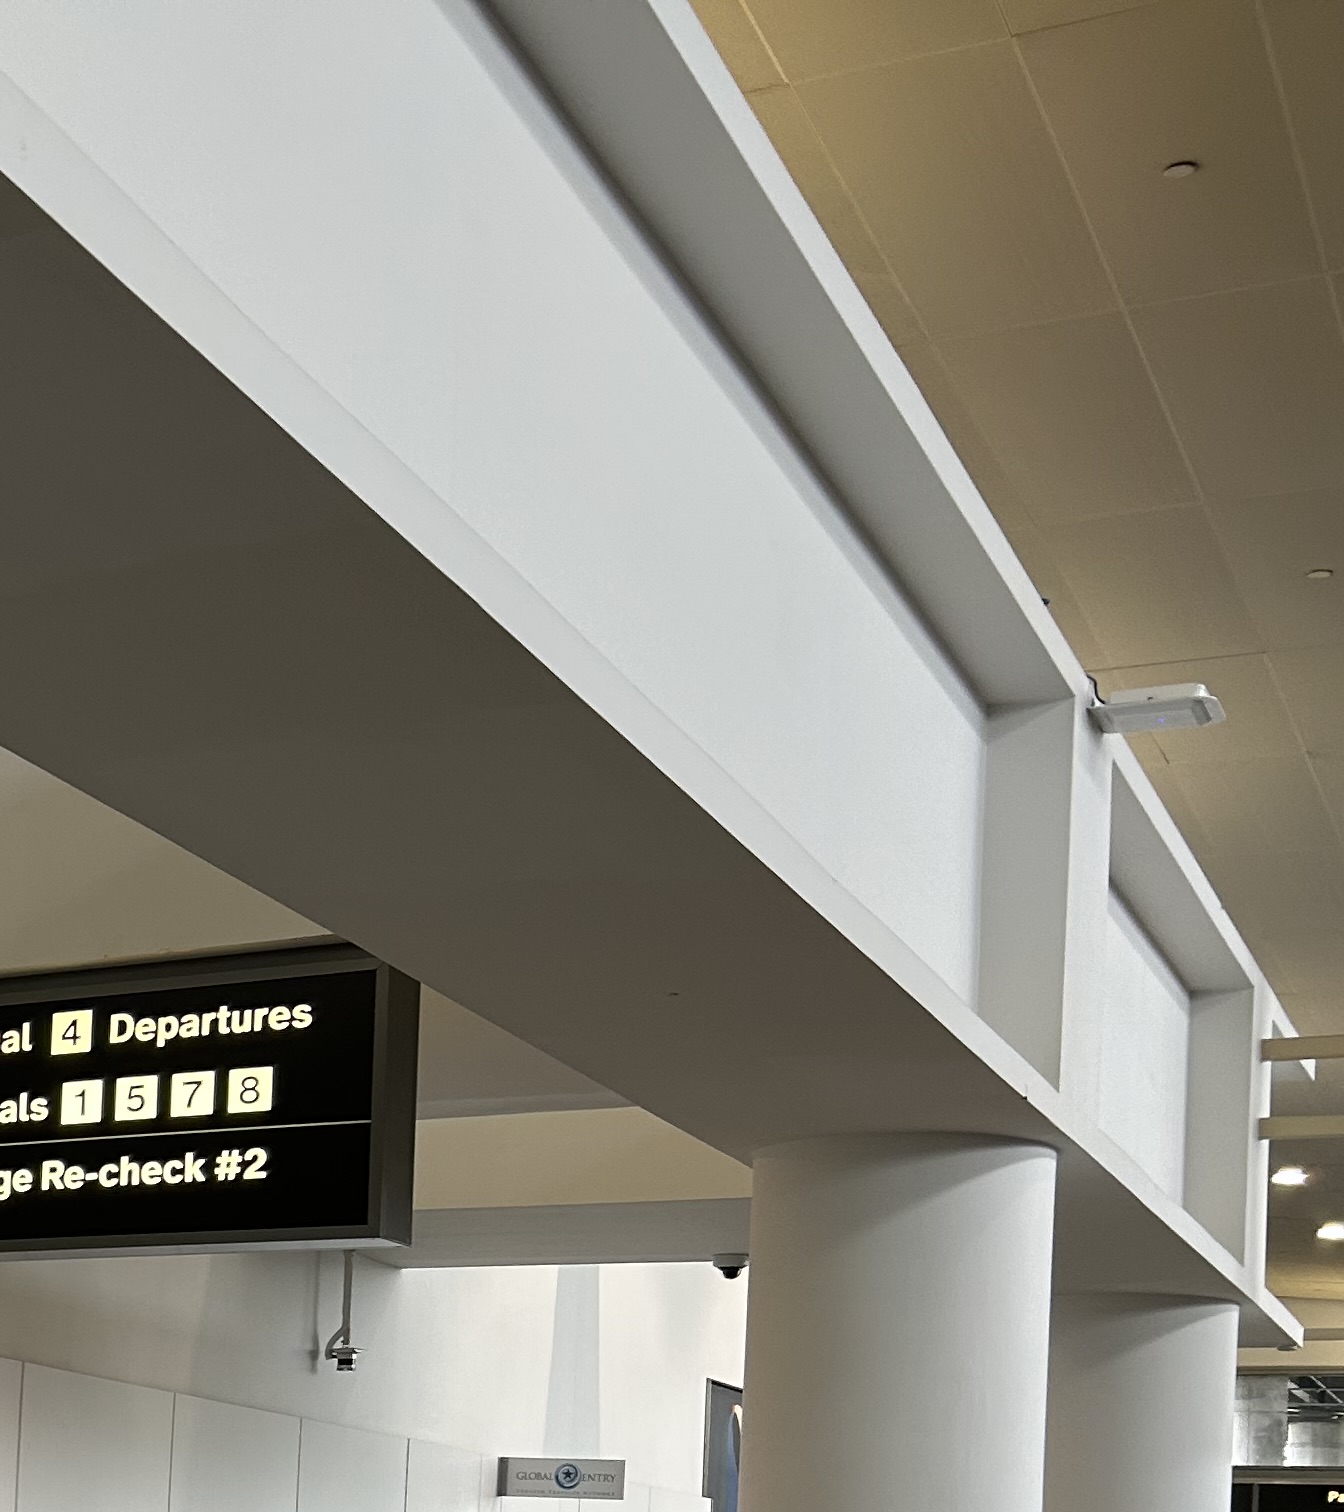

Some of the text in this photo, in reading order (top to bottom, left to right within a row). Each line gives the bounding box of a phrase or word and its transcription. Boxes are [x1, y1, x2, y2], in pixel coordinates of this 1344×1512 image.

[109, 1003, 313, 1048] Departures
[41, 1152, 206, 1191] Re-check
[214, 1146, 269, 1182] #2
[516, 1471, 553, 1481] GLOBAL
